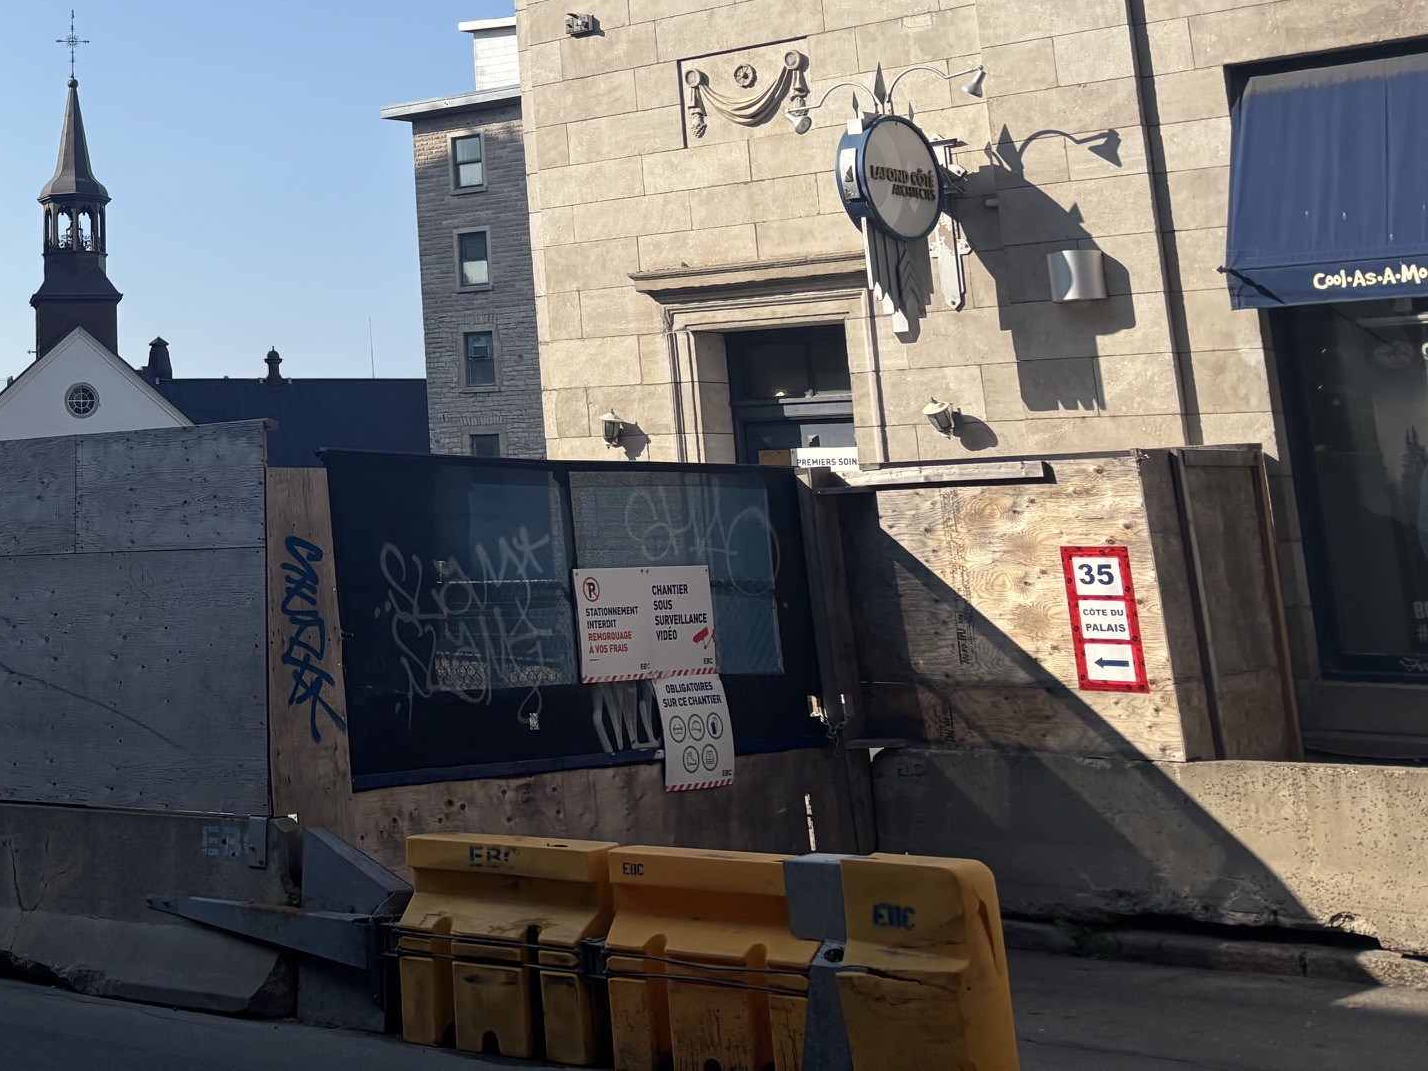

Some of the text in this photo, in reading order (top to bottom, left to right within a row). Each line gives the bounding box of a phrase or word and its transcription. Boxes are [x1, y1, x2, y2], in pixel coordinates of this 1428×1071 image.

[870, 165, 935, 188] LAFOND CÔTÉ
[796, 458, 837, 466] PREMIERS
[1077, 563, 1115, 586] 35
[651, 584, 689, 596] CHANTIER
[653, 599, 673, 611] SOUS
[585, 606, 639, 617] STATIONNEMENT
[1082, 608, 1124, 617] CÔTE DU
[586, 619, 617, 629] INTERDIT
[654, 613, 708, 626] SURVEILLANCE
[655, 626, 678, 641] VIDÉO
[1085, 623, 1126, 633] PALAIS
[588, 643, 629, 654] À VOS FRAIS
[703, 657, 713, 665] EBC
[665, 681, 714, 694] OBLIGATOIRES
[663, 694, 723, 708] SUR CE CHANTIER
[722, 769, 733, 777] EBC
[622, 861, 644, 877] EBC
[872, 902, 916, 930] EBC
